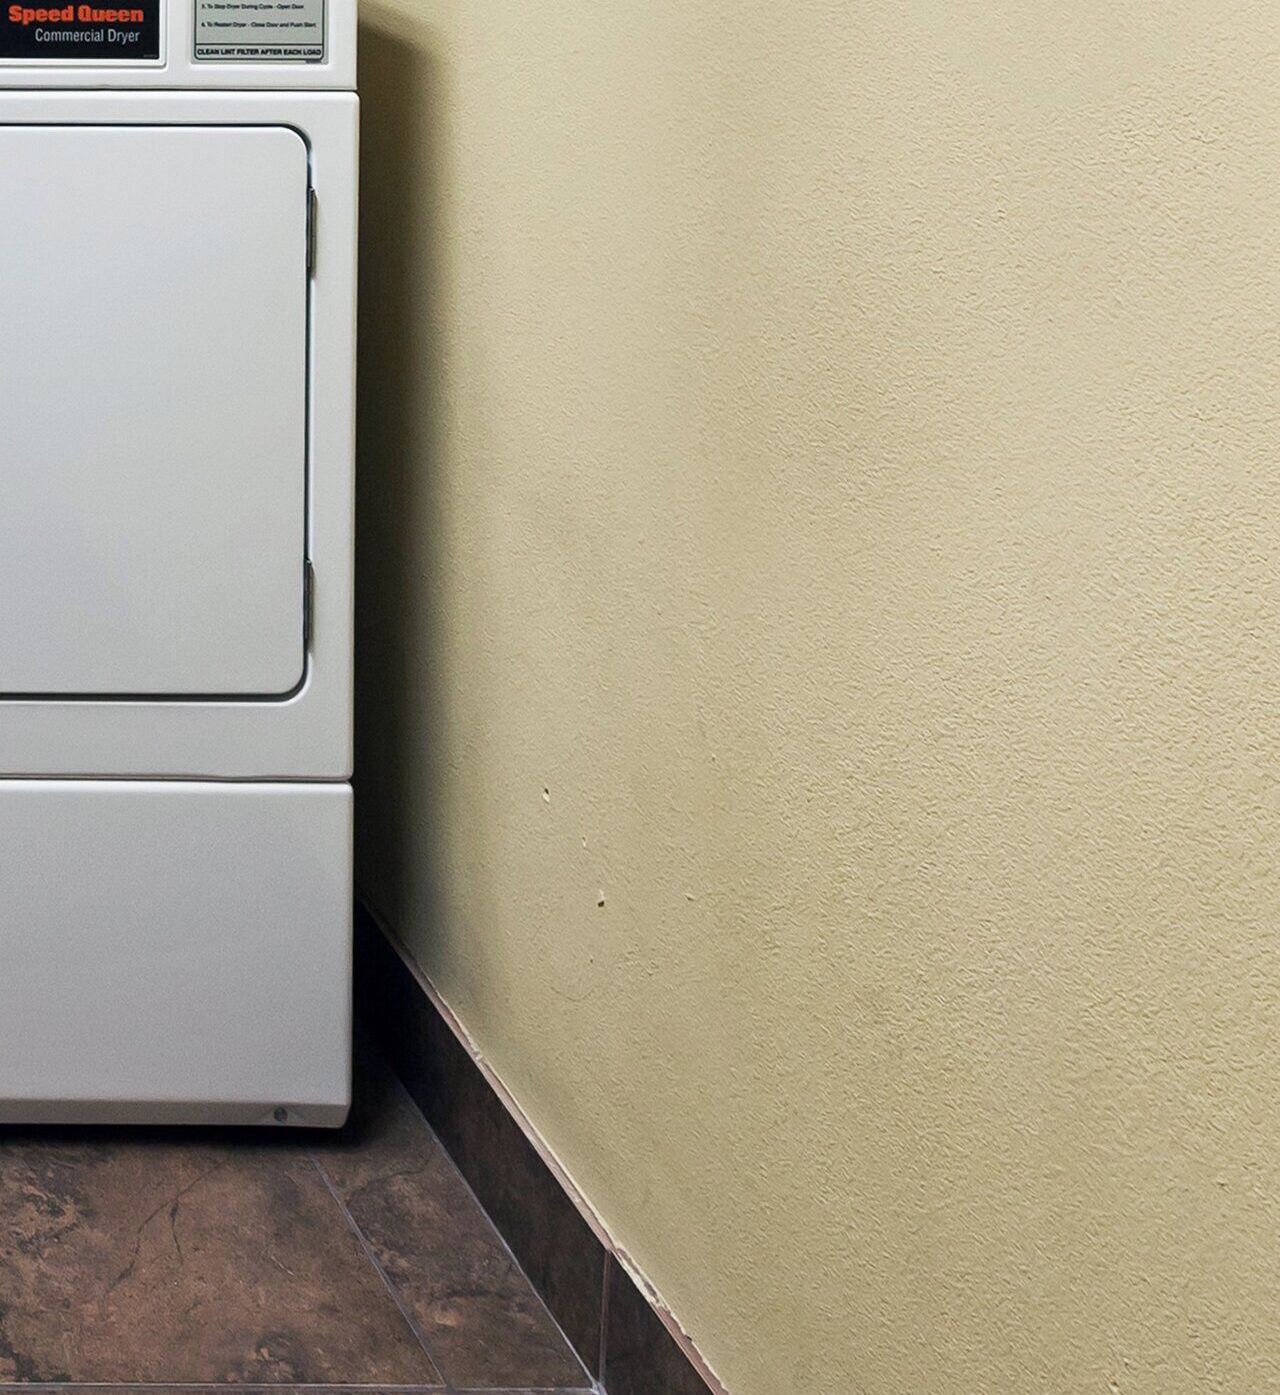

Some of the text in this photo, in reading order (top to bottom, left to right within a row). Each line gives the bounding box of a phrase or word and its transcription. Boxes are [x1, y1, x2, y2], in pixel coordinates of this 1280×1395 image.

[8, 4, 144, 25] Speed Queen
[35, 28, 140, 45] Commercial Dryer
